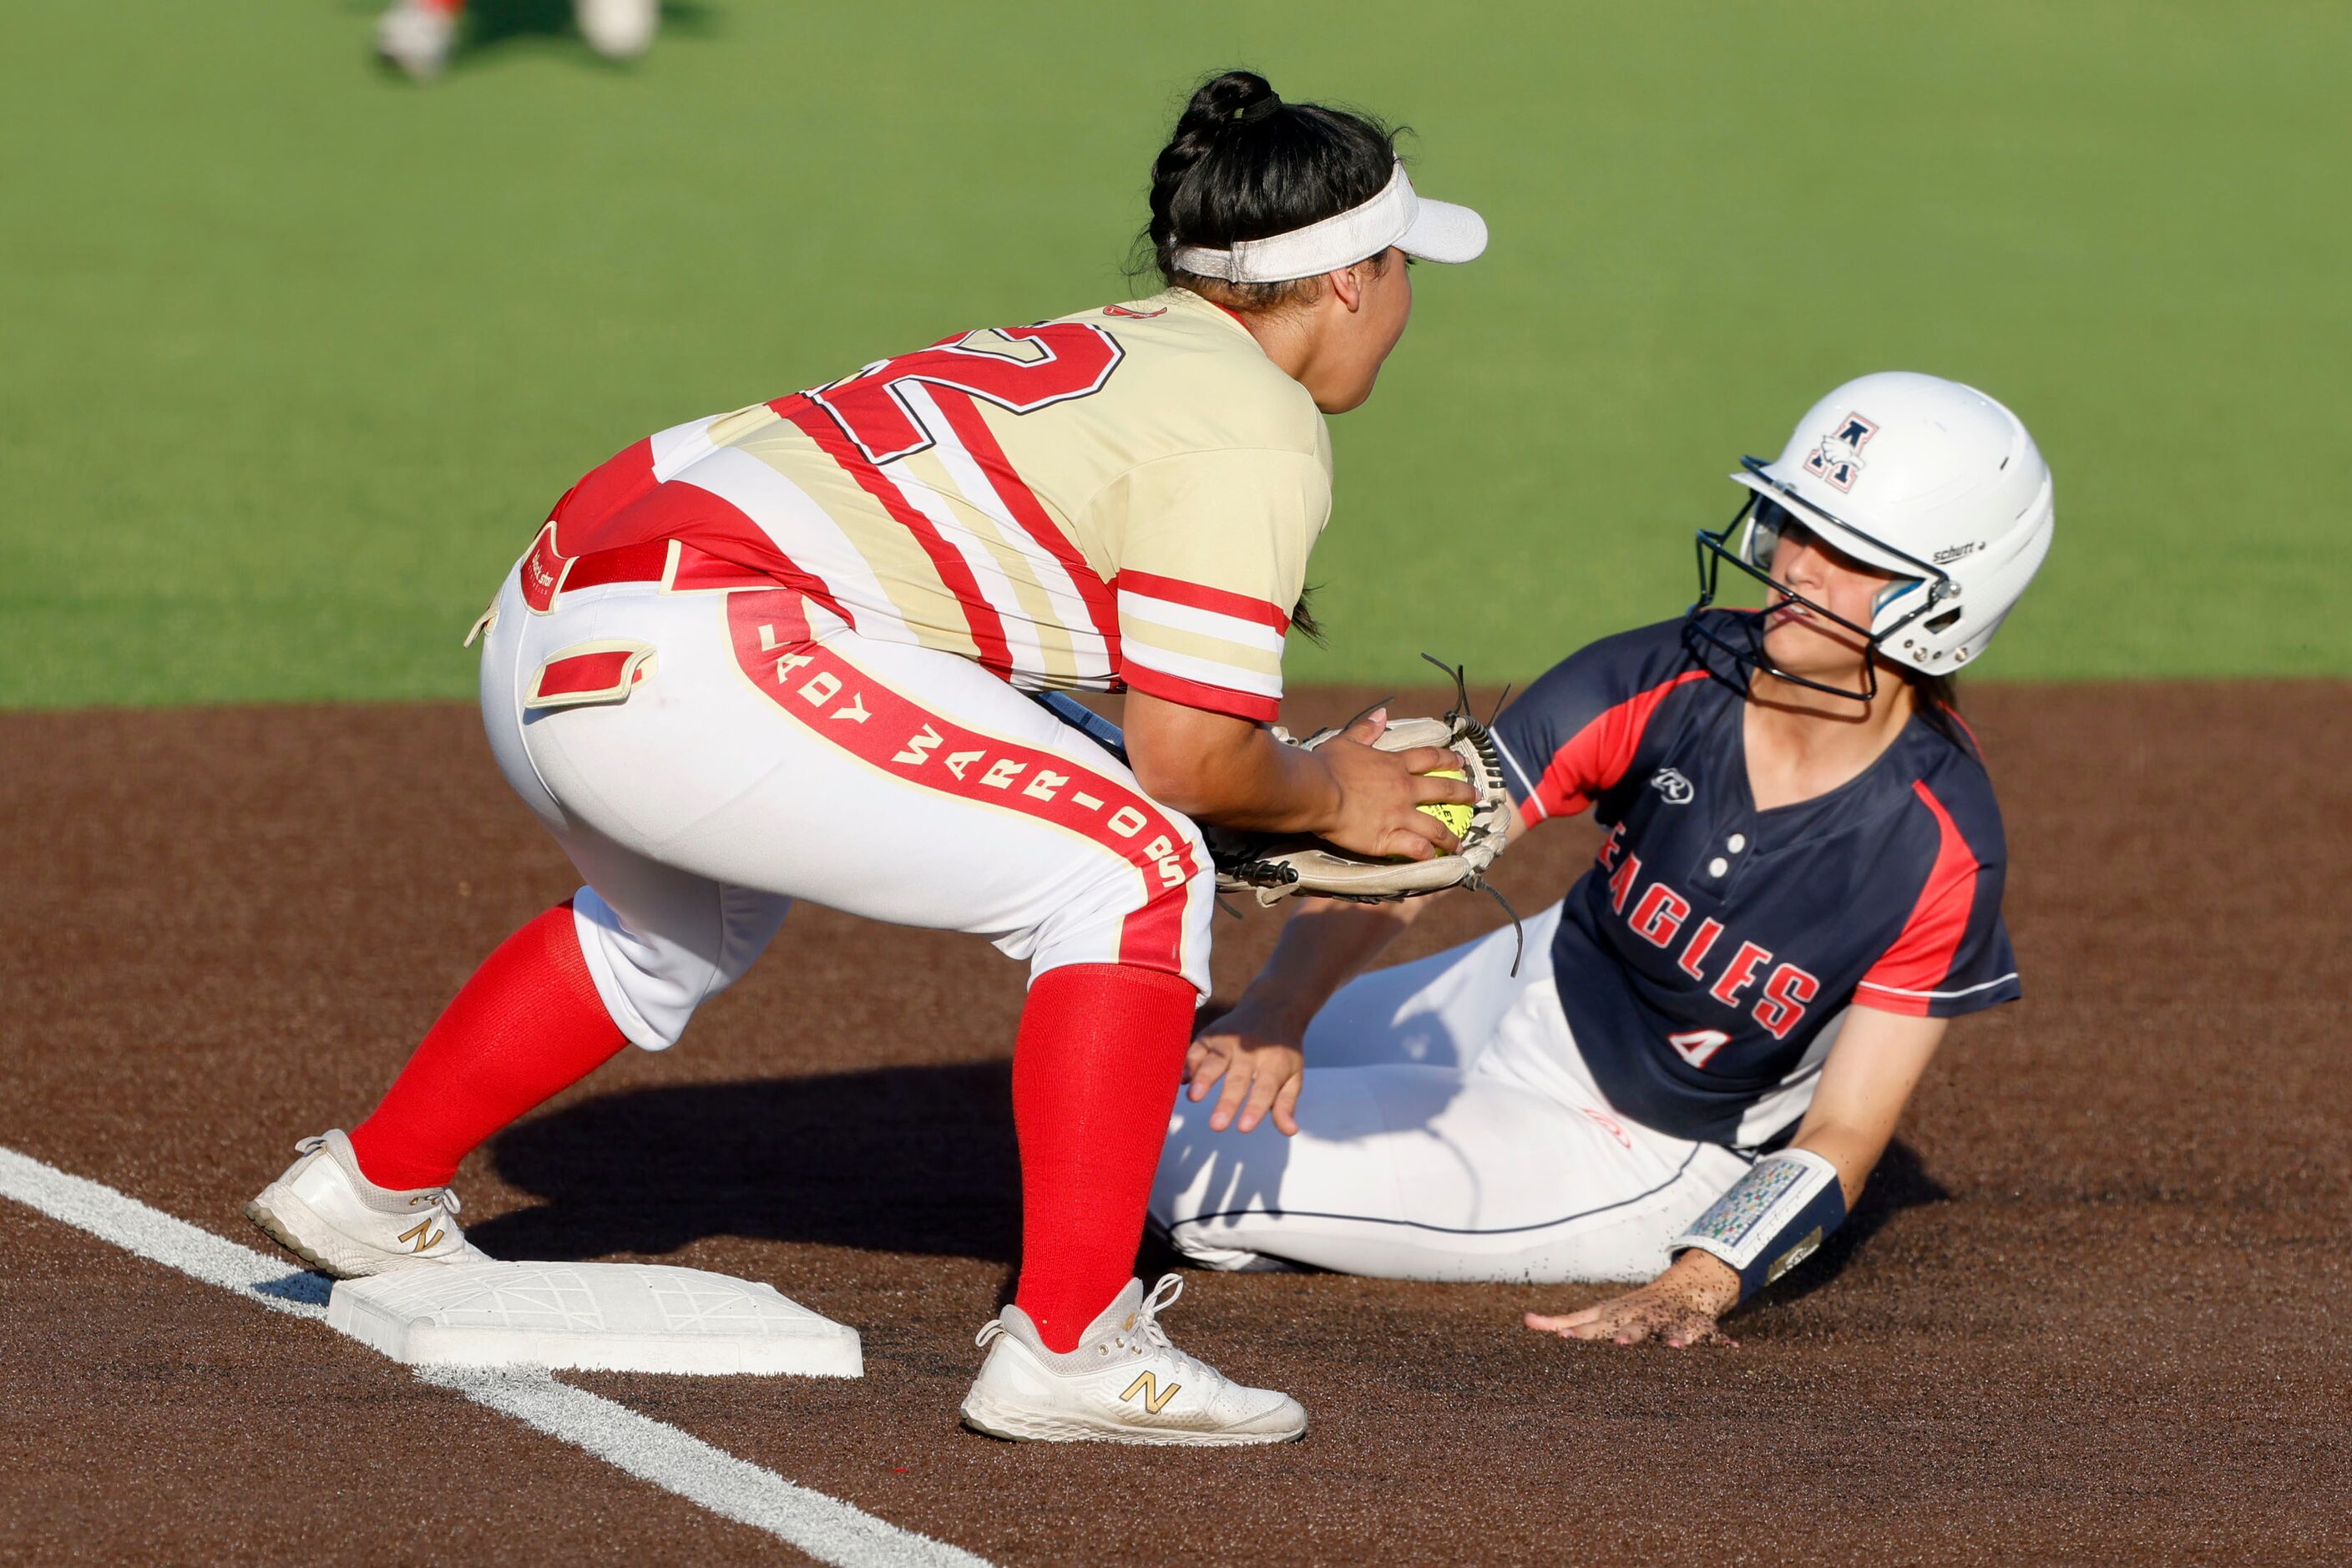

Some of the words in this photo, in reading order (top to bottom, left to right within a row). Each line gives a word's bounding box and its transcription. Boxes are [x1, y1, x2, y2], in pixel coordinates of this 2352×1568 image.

[805, 321, 1125, 466] 2
[539, 571, 554, 587] star
[756, 624, 873, 725] LADY
[890, 723, 1186, 888] WARRIORS
[1596, 821, 1820, 1039] EAGLES
[1667, 1029, 1732, 1070] 4
